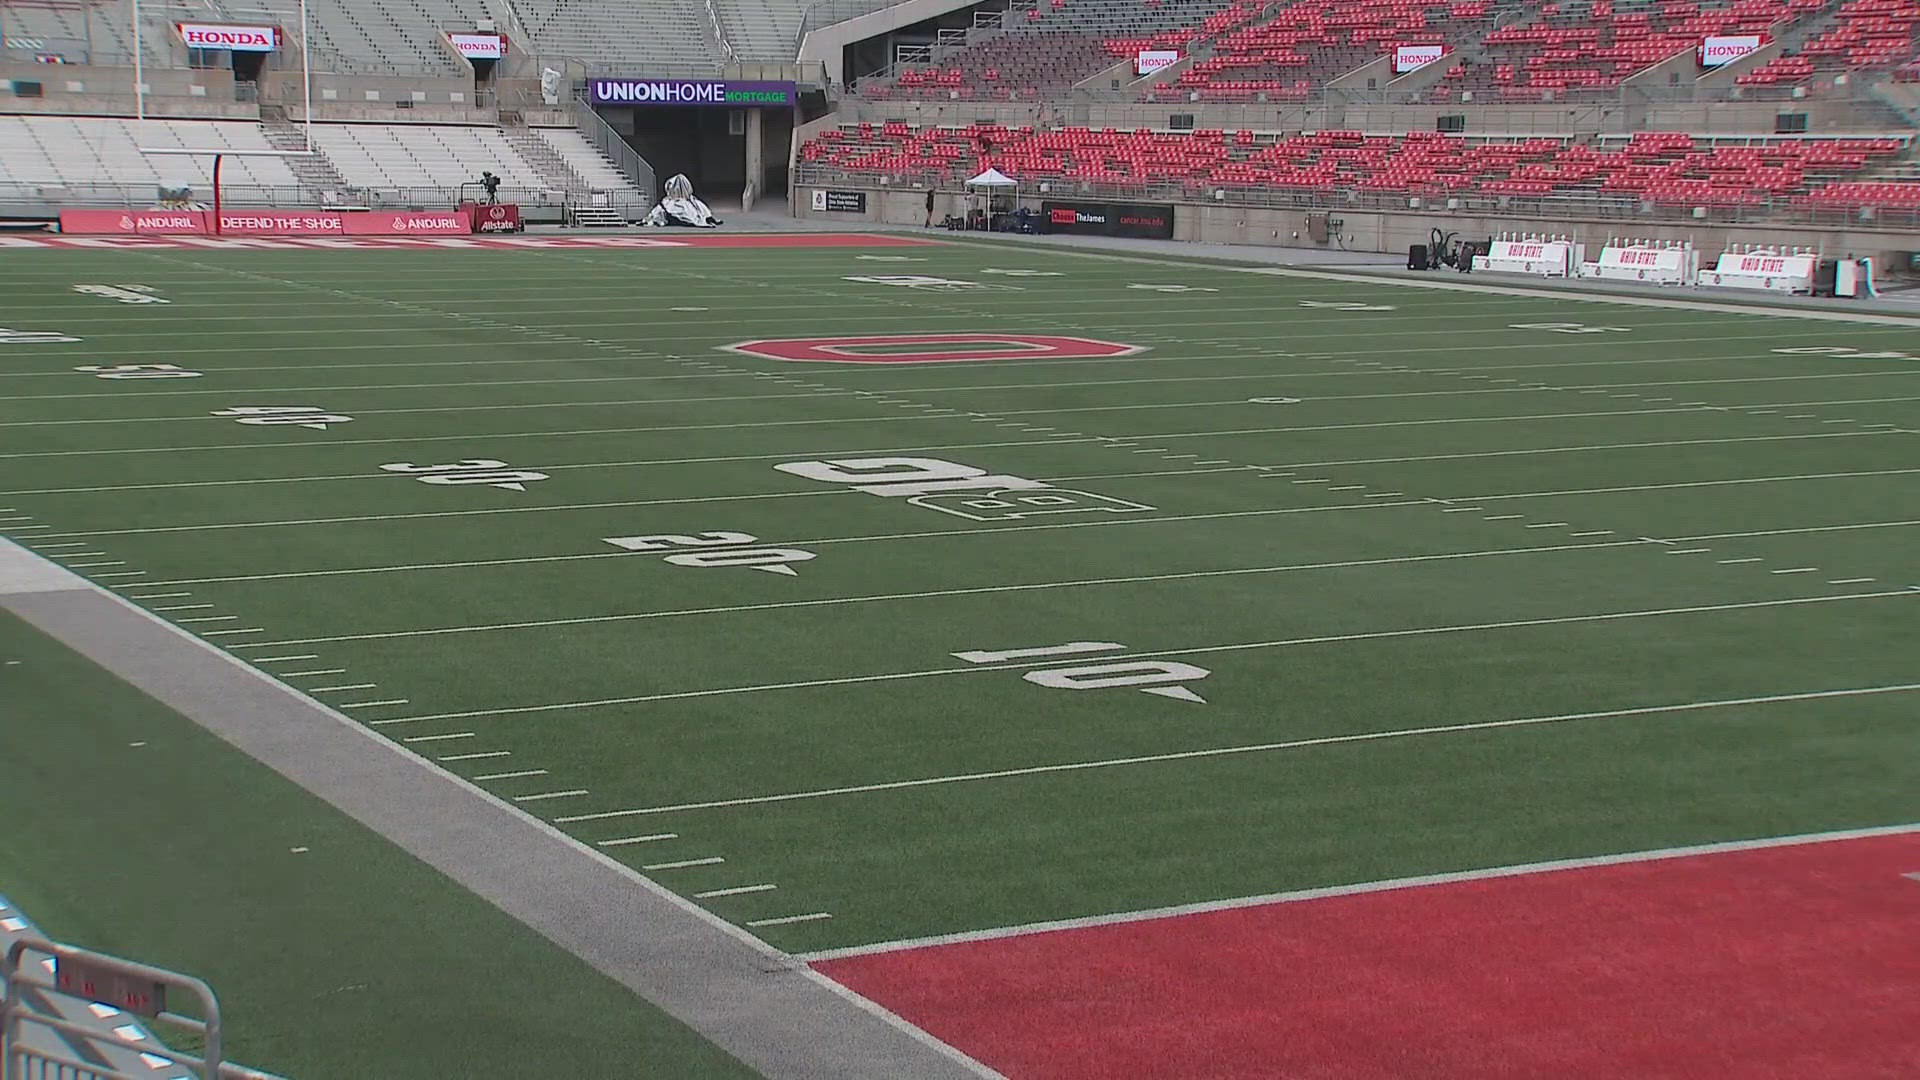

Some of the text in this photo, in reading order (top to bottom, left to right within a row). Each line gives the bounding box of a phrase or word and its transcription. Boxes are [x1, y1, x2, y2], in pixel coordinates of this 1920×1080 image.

[187, 31, 269, 45] HONDA
[455, 42, 497, 51] HONDA
[725, 92, 786, 103] MORTGAGE
[137, 217, 196, 228] ANDURIL
[221, 217, 274, 228] DEFEND
[274, 218, 302, 229] THE
[408, 218, 460, 229] ANDURIL
[481, 220, 514, 231] Allstate
[1508, 244, 1544, 258] OHIO STATE
[1620, 250, 1658, 266] OHIO STATE
[1741, 257, 1784, 273] OHIO STATE
[379, 458, 550, 485] 30
[601, 530, 818, 568] 20
[950, 641, 1212, 690] 10
